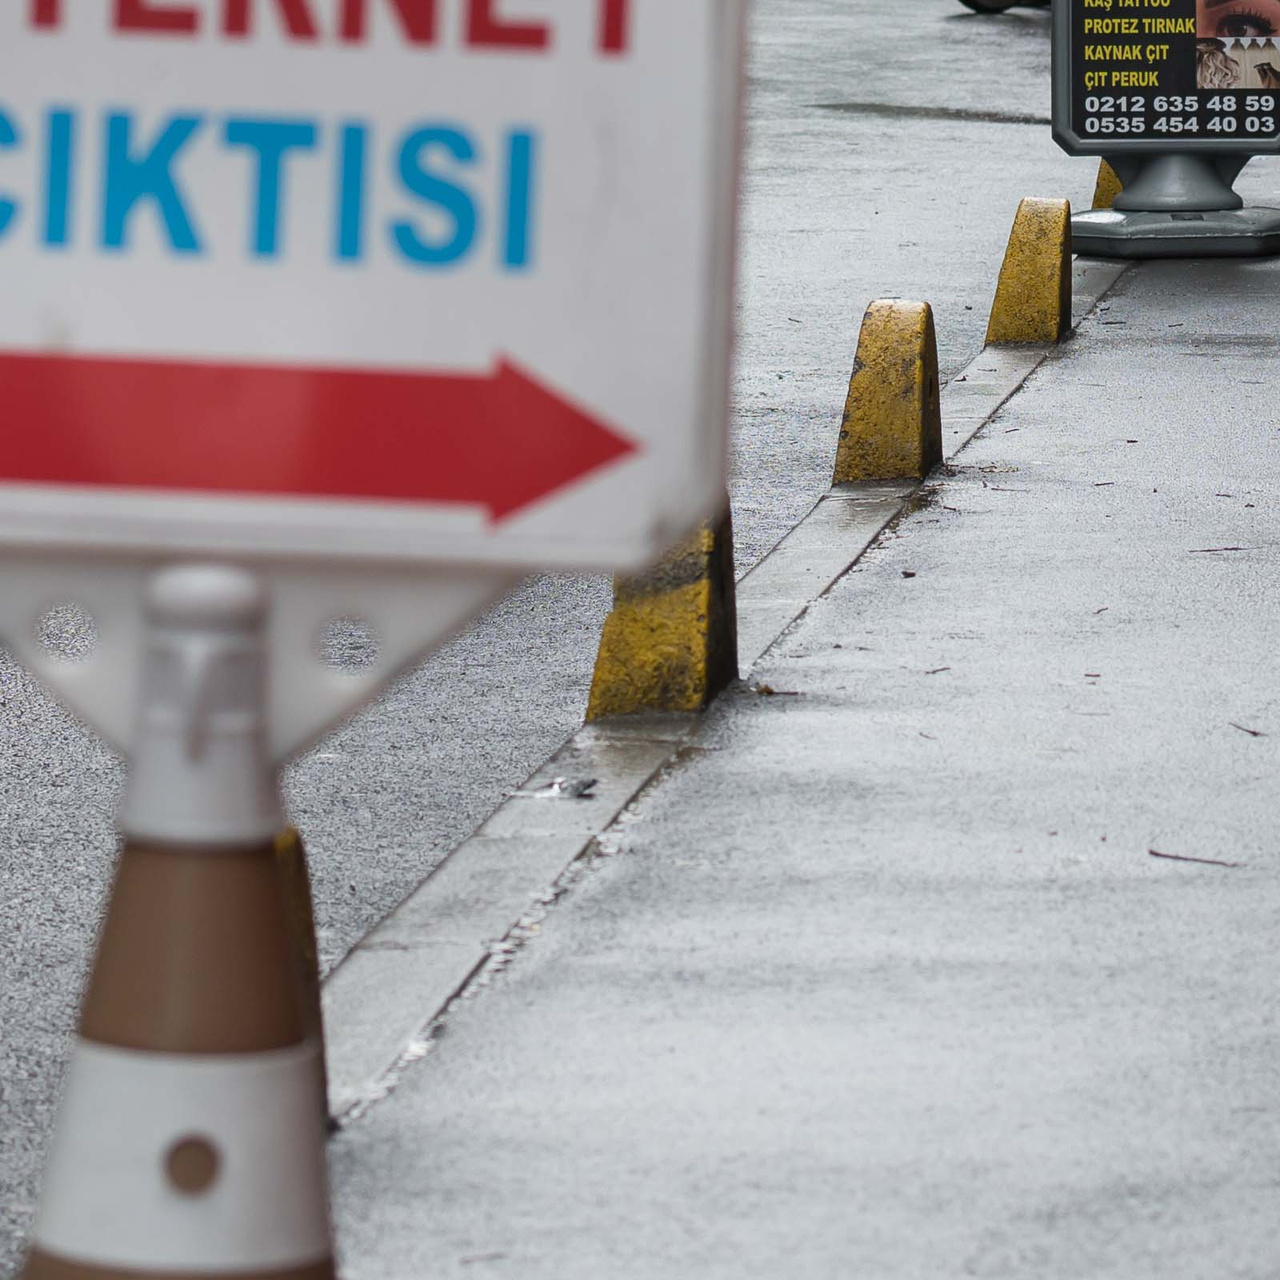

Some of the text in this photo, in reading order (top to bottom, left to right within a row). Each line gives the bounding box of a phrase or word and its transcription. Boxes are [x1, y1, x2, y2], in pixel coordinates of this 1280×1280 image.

[1084, 18, 1195, 34] PROTEZ TIRNAK
[1084, 45, 1169, 64] KAYNAK ÇIT
[1084, 71, 1159, 90] ÇIT PERUK
[1085, 96, 1275, 112] 0212 635 48 59
[1085, 116, 1275, 133] 0535 454 40 03
[0, 102, 536, 270] IKTISI
